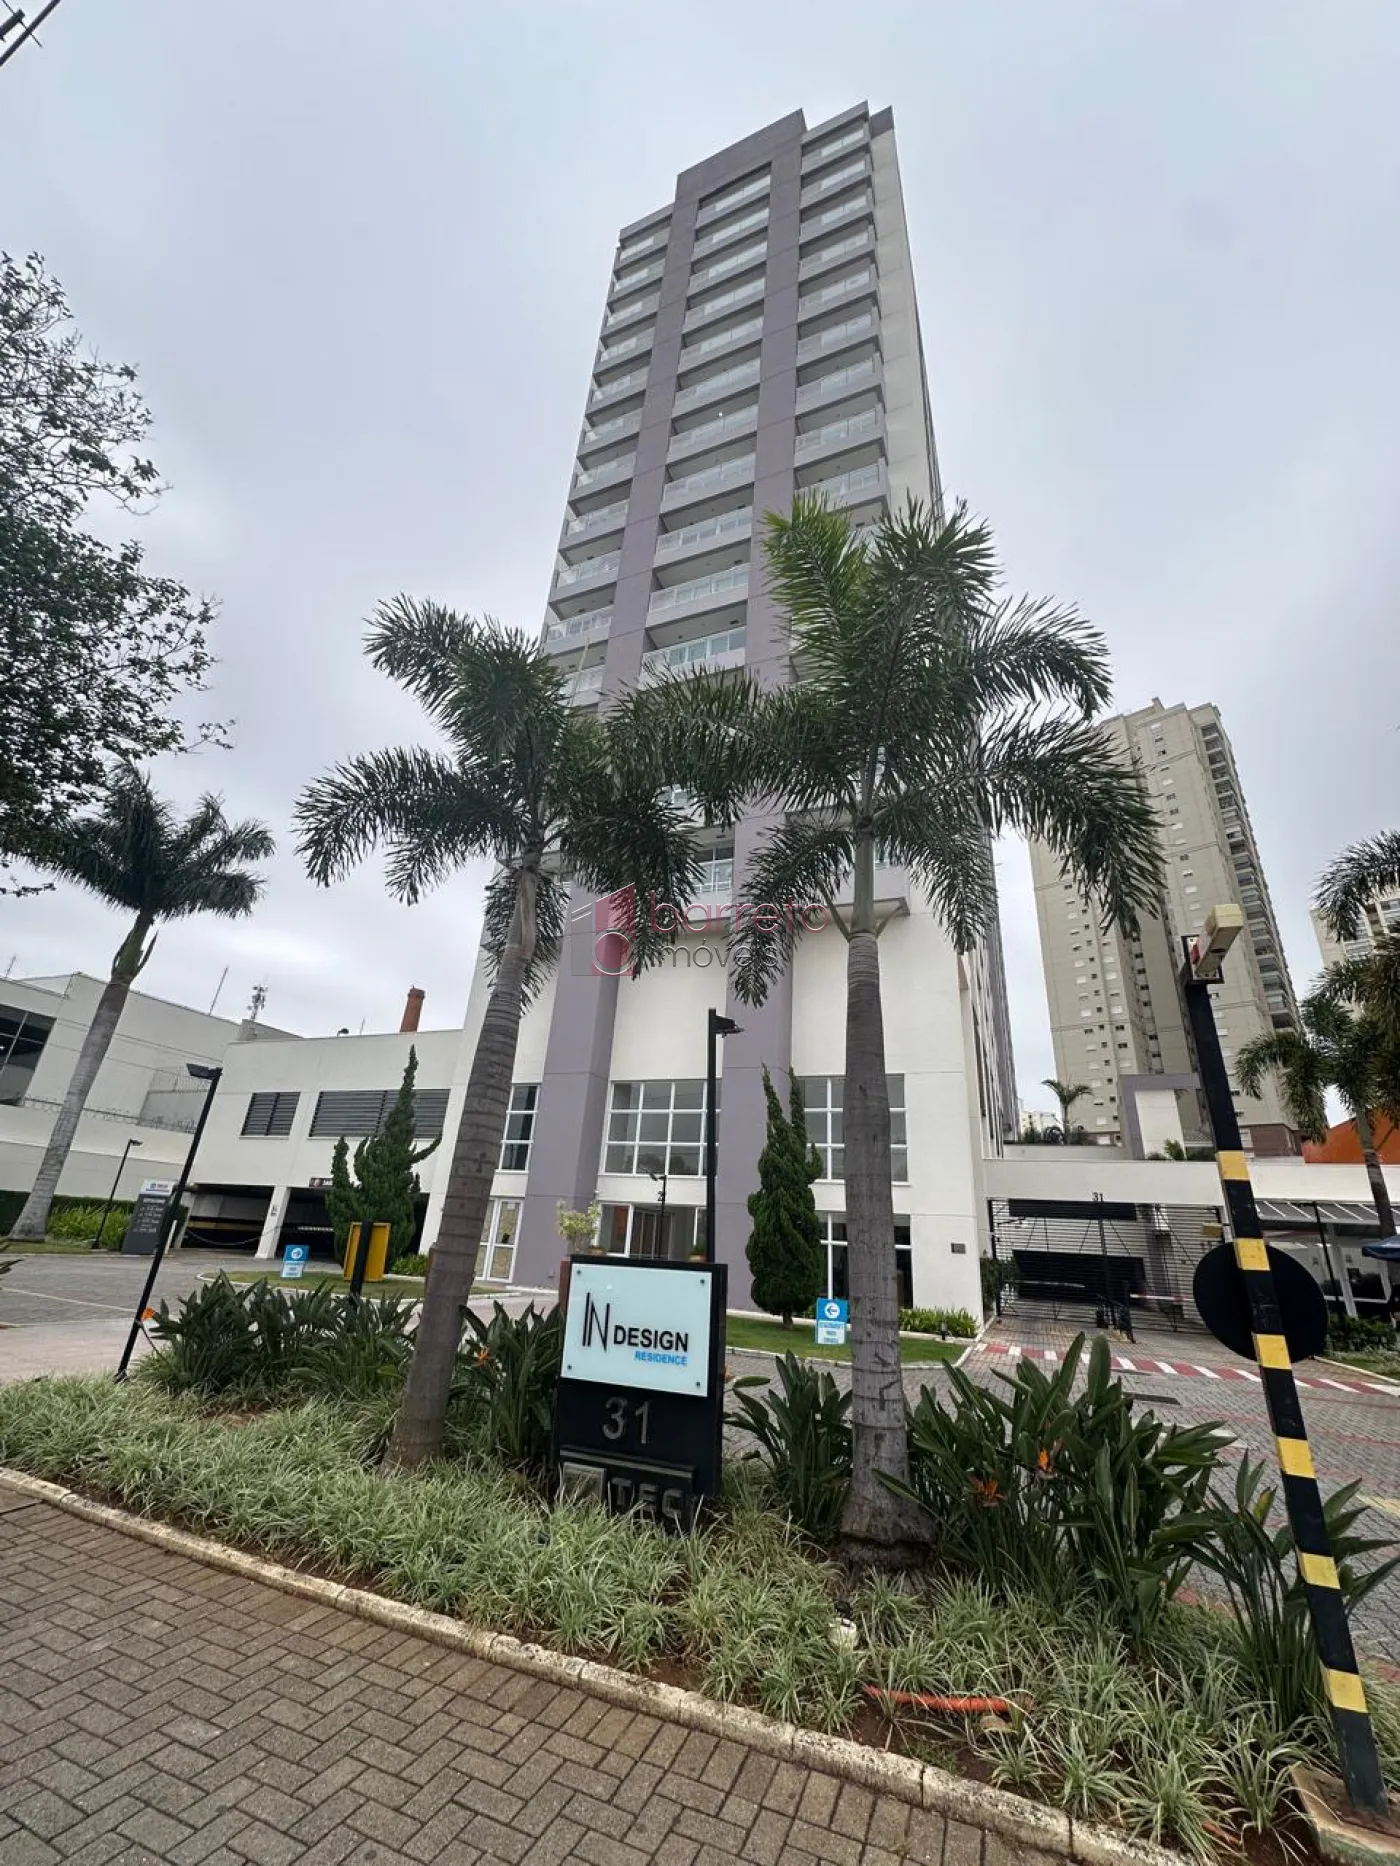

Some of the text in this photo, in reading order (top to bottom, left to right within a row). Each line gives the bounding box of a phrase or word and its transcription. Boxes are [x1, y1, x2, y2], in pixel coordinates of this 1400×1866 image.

[1092, 1191, 1104, 1203] 31
[582, 1292, 689, 1353] IN DESIGN
[634, 1350, 688, 1366] RESIDENCE
[602, 1397, 650, 1445] 31
